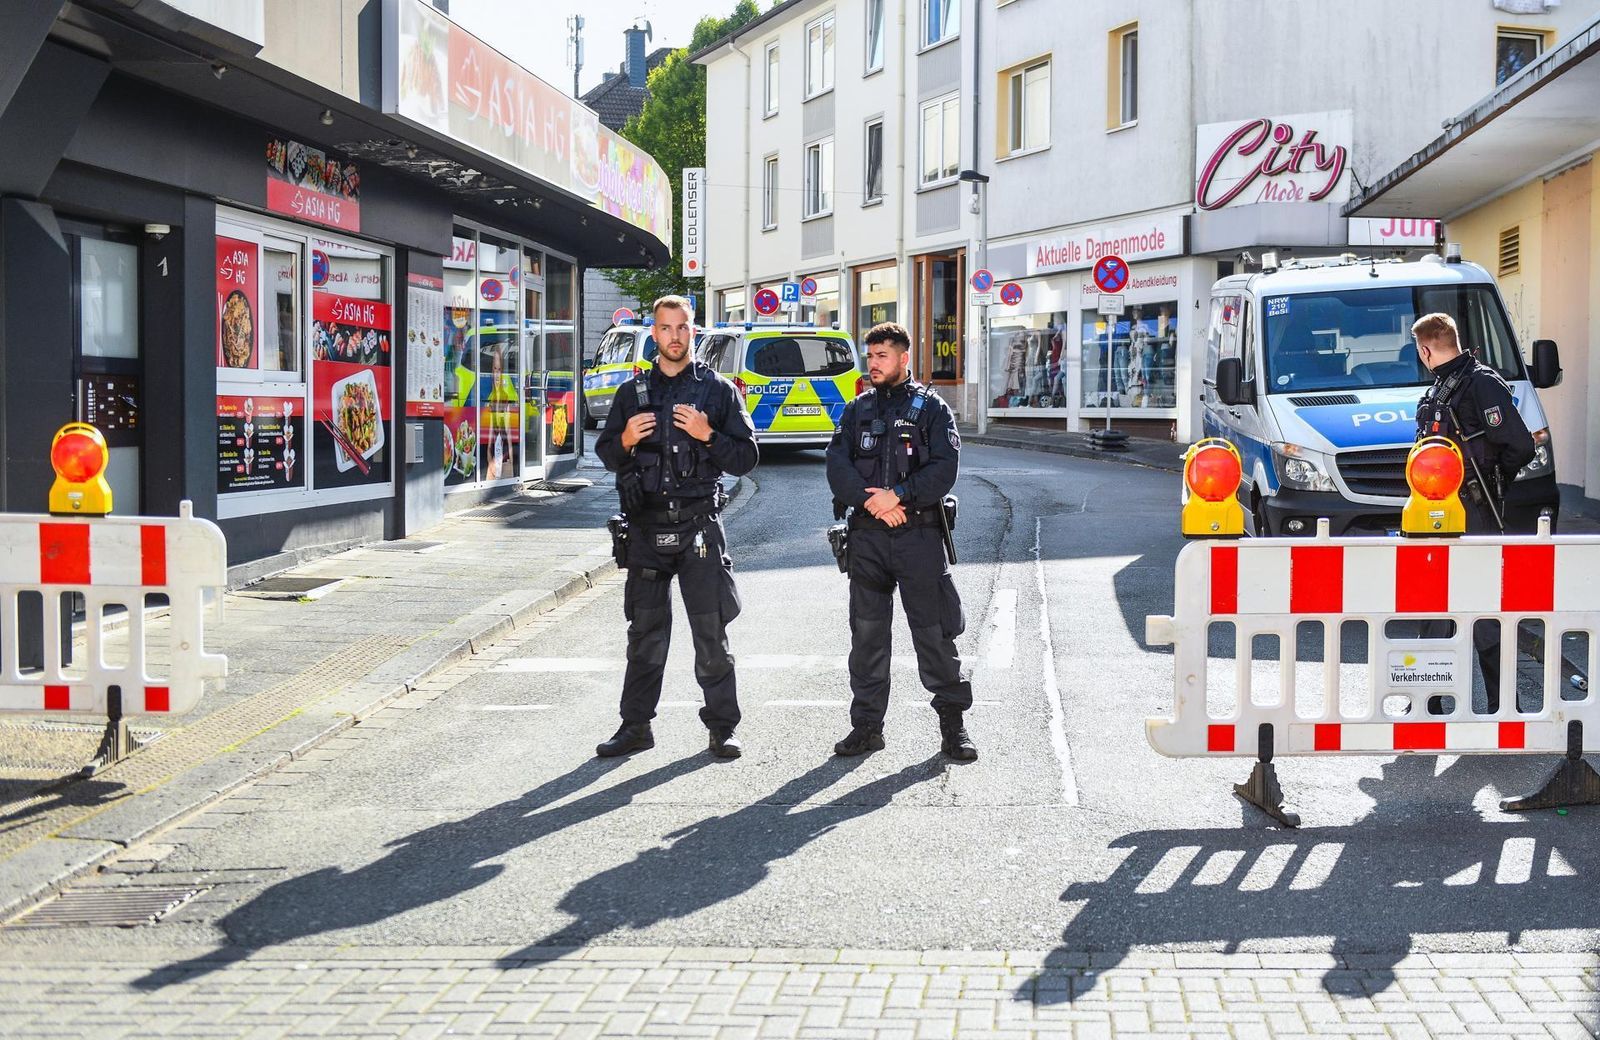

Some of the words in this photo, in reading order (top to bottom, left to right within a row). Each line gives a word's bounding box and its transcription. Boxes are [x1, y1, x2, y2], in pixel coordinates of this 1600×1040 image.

[488, 73, 536, 148] ASIA
[543, 106, 564, 163] HG
[1196, 118, 1347, 211] City
[1261, 179, 1304, 201] Mode
[305, 196, 325, 218] ASIA
[327, 201, 340, 224] HG
[687, 171, 698, 254] LEDLENSER
[1036, 240, 1081, 268] Aktuelle
[1085, 227, 1165, 261] Damenmode
[157, 256, 168, 276] 1
[232, 250, 249, 267] ASIA
[235, 270, 246, 285] HG
[1132, 275, 1177, 290] Abendkleidung
[784, 285, 795, 300] P
[1267, 297, 1290, 305] NRW
[1194, 299, 1200, 310] 4
[1271, 302, 1286, 310] 210
[343, 305, 361, 322] ASIA
[363, 305, 375, 324] HG
[747, 384, 788, 395] POLIZEI
[1391, 671, 1453, 682] Verkehrstechnik
